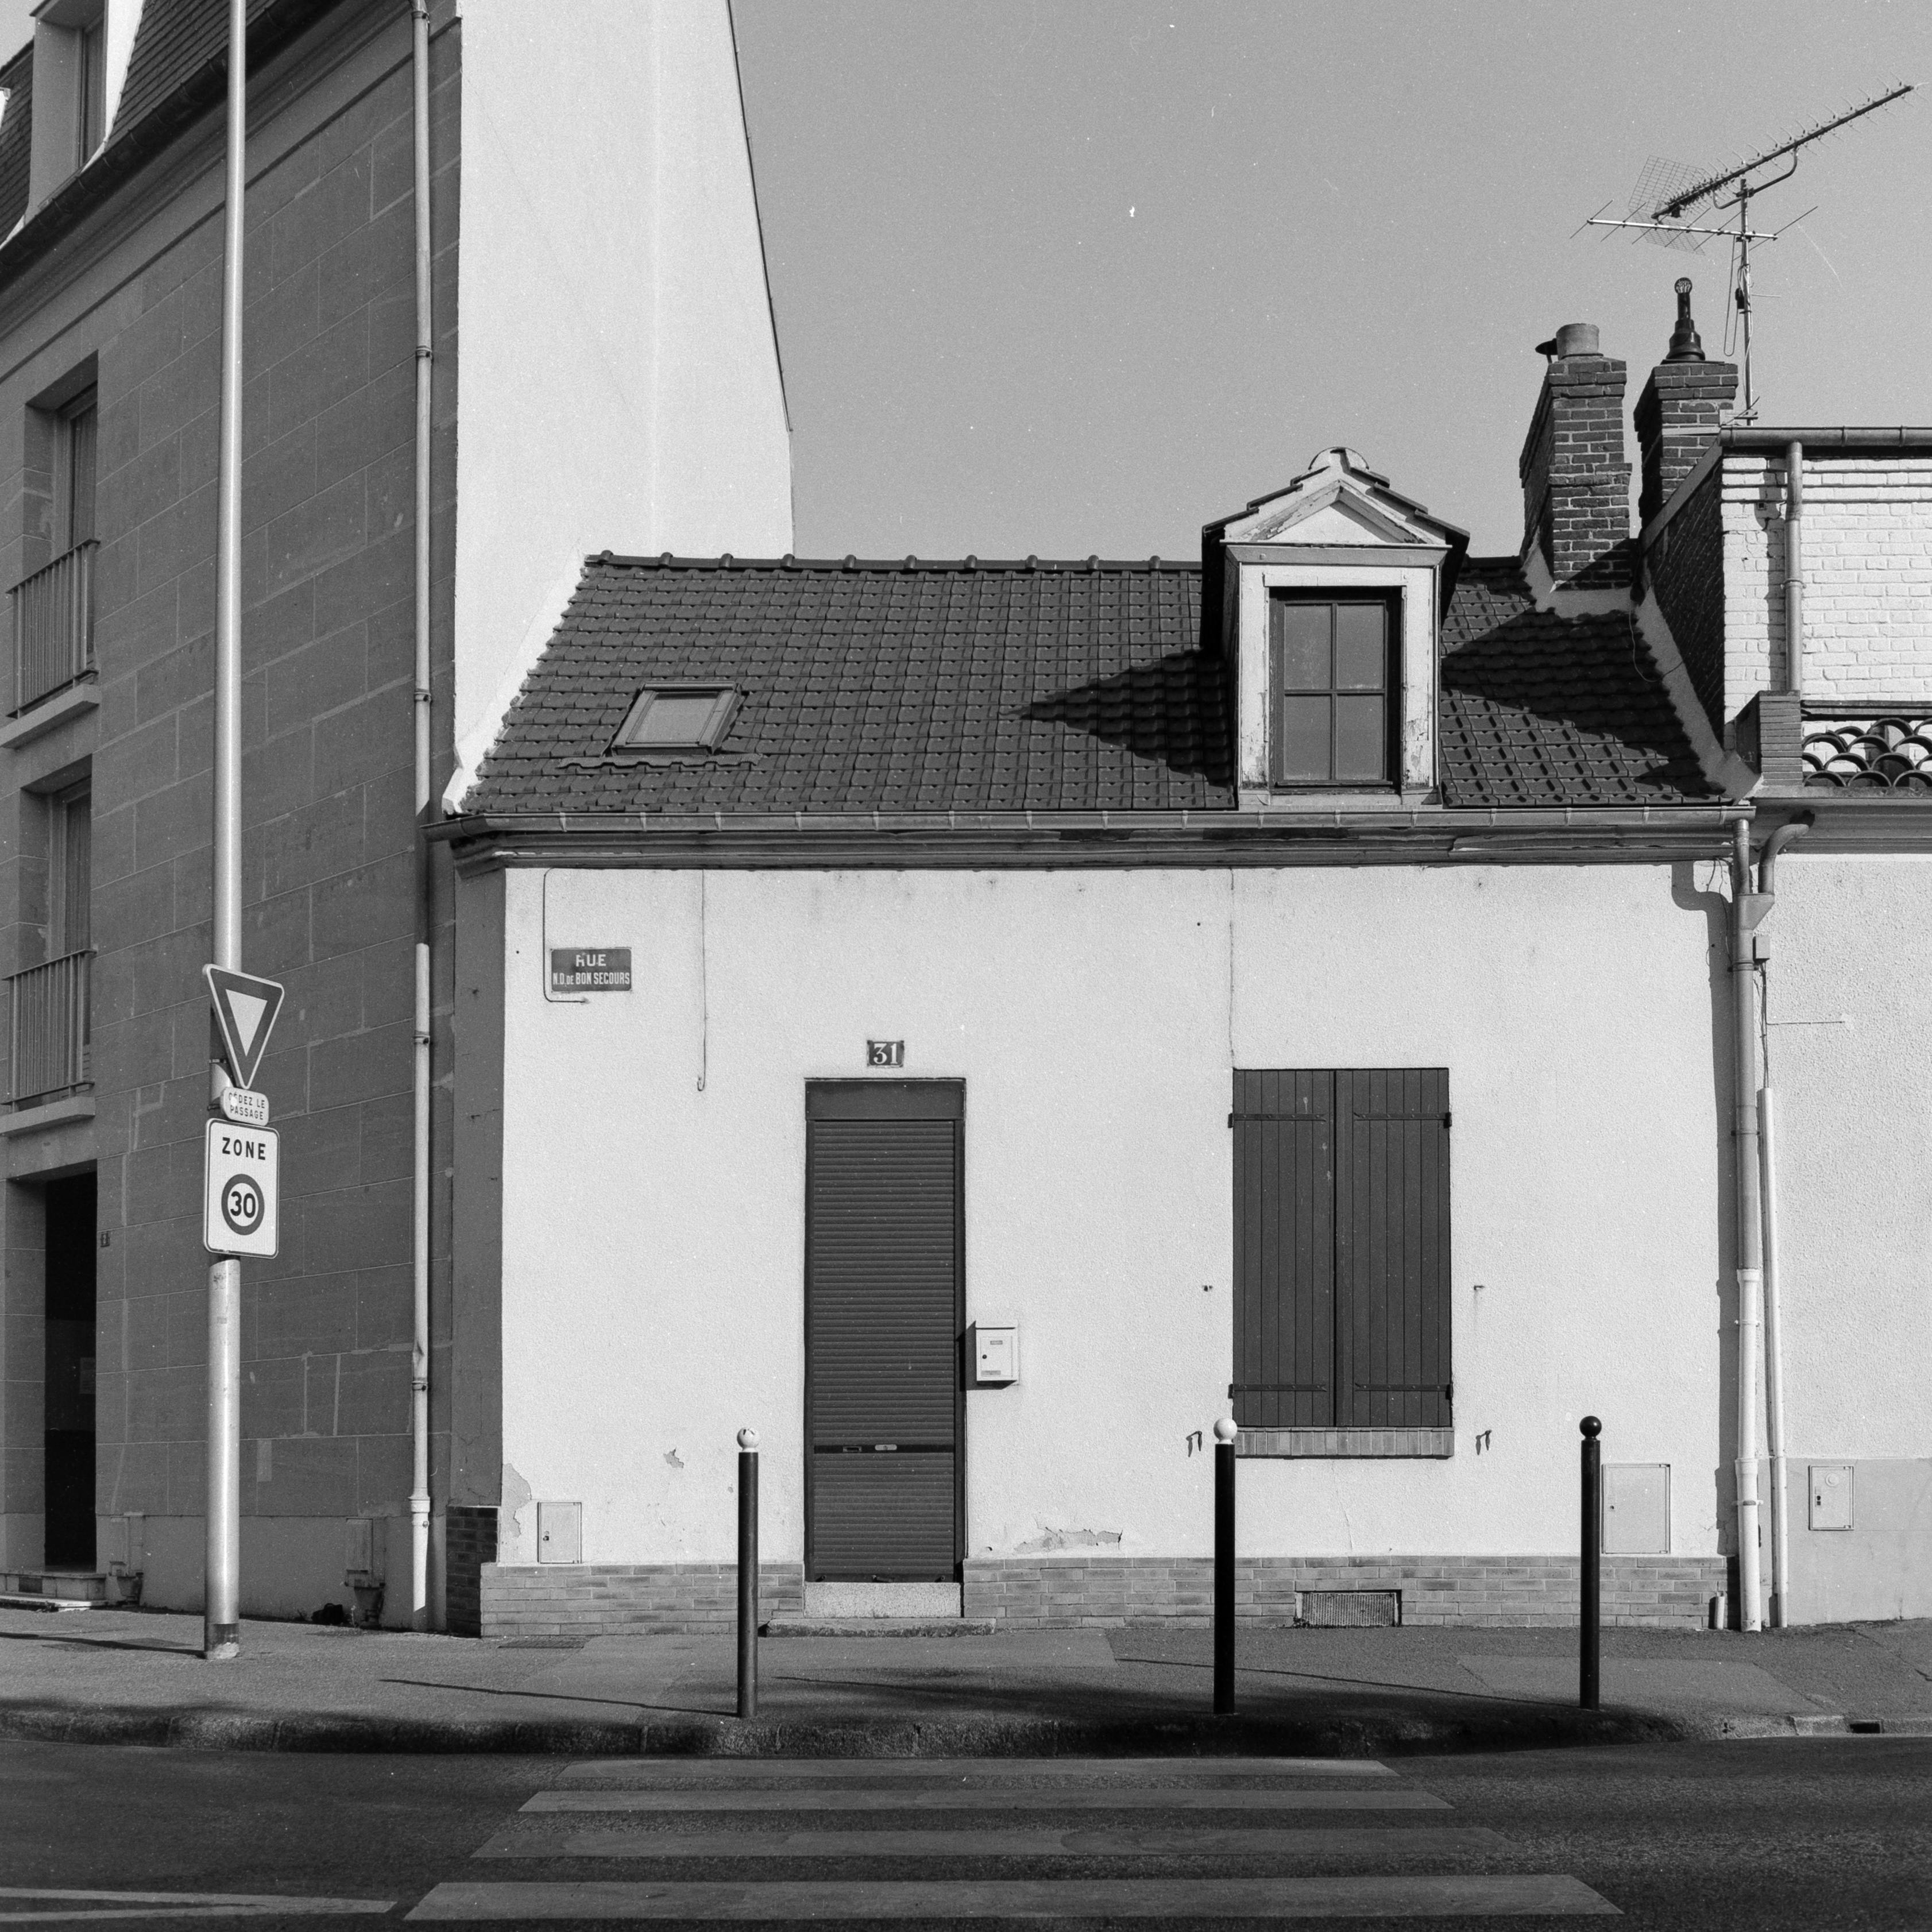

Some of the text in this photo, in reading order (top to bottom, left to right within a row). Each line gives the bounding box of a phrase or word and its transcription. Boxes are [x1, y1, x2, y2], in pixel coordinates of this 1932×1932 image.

[575, 954, 606, 967] RUE
[575, 972, 592, 985] BON
[593, 972, 630, 984] SECOURS
[873, 1043, 898, 1064] 31
[257, 1099, 265, 1108] LE
[230, 1105, 264, 1120] PASSAGE
[222, 1137, 266, 1161] ZONE
[230, 1191, 256, 1218] 30
